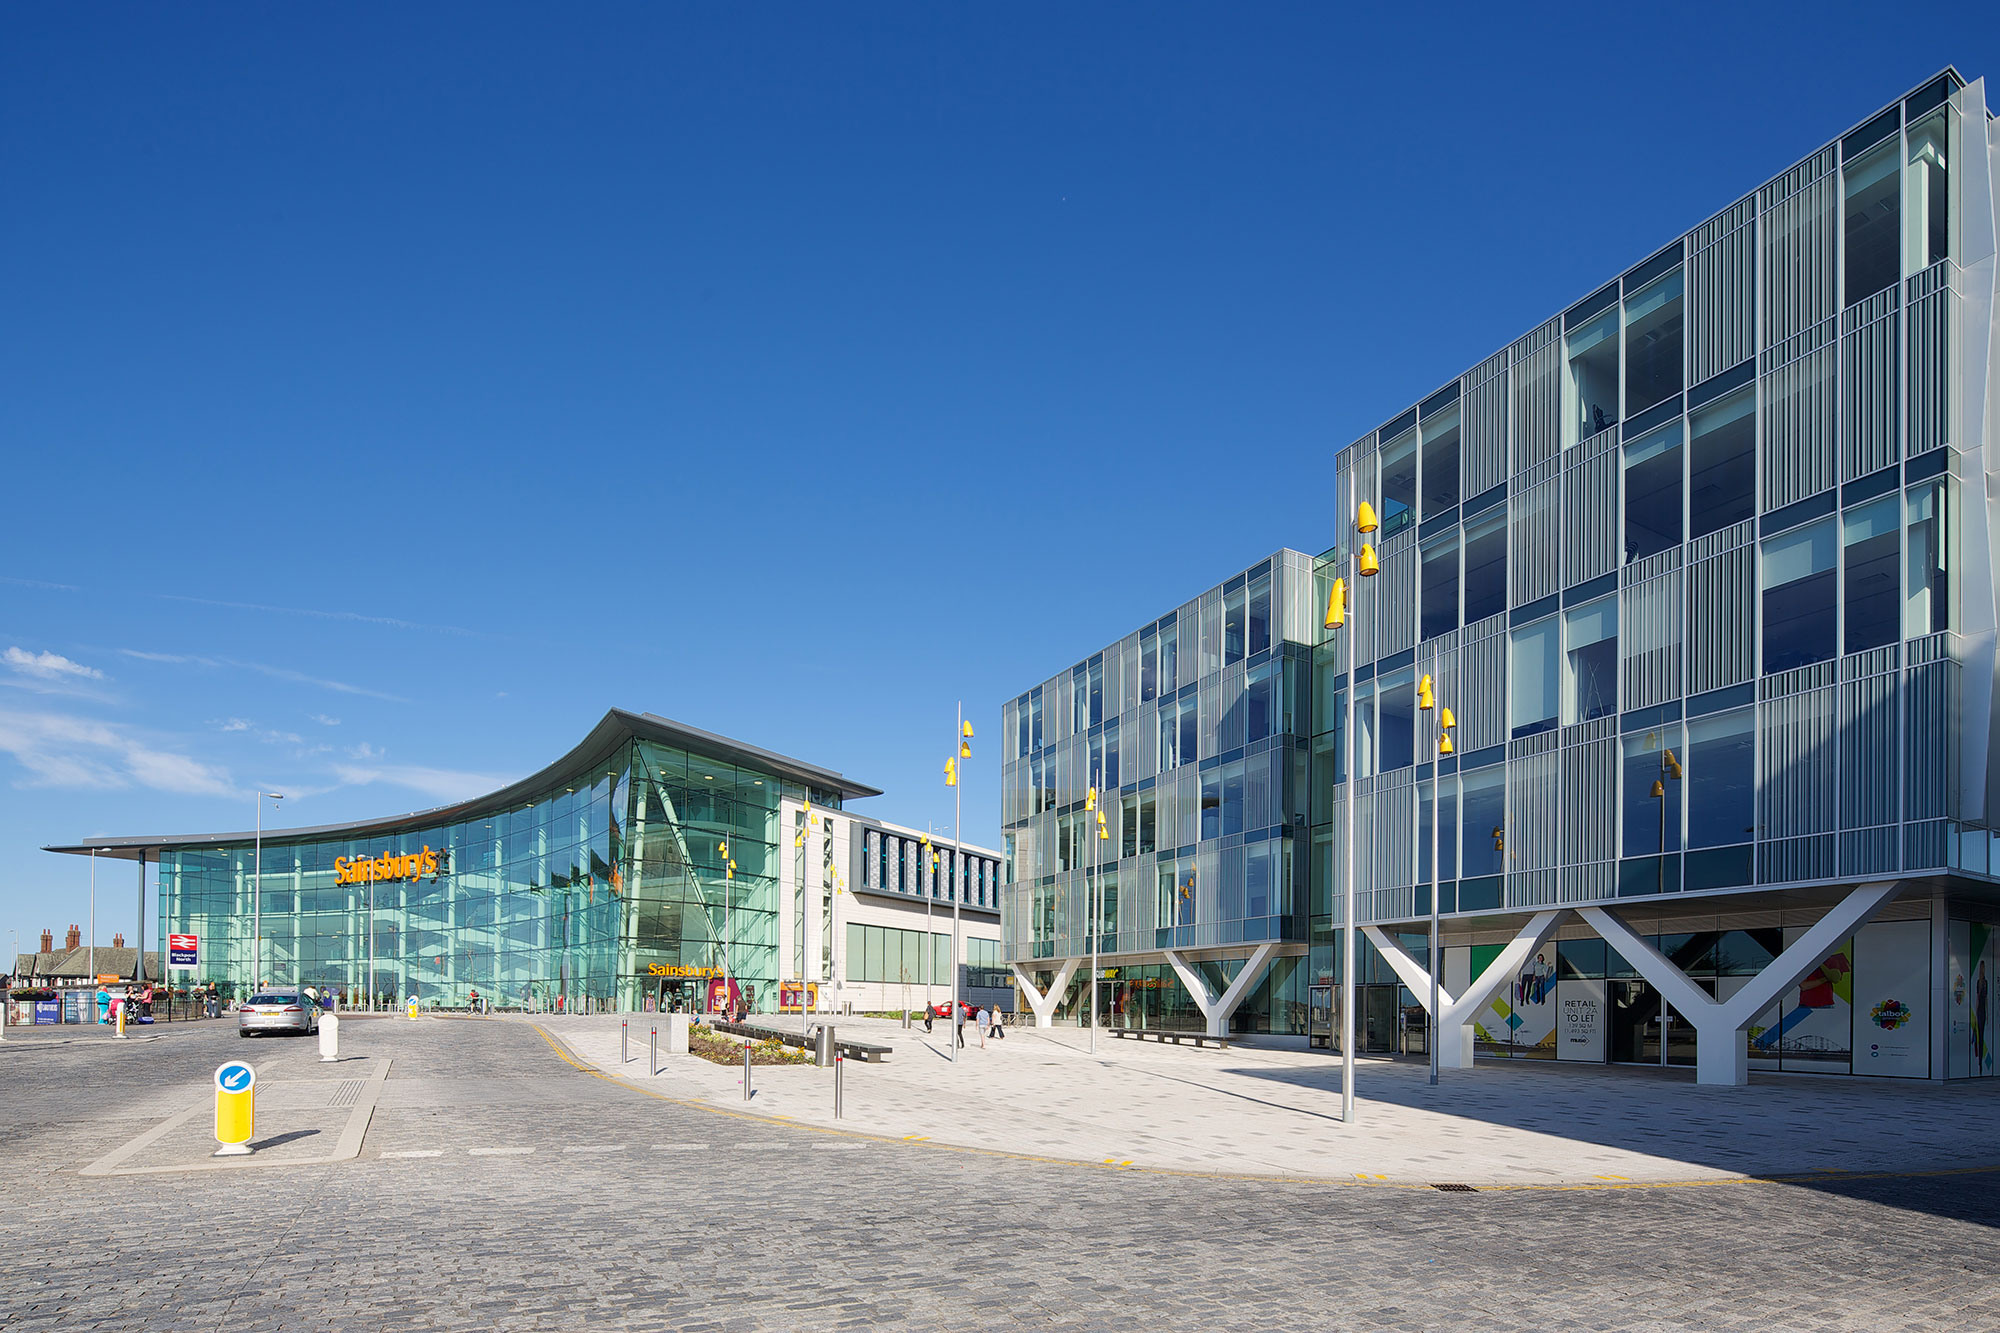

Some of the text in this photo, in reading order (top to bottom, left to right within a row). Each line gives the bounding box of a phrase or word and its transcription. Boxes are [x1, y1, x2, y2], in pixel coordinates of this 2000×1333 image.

[334, 845, 437, 884] Sainsbury's
[648, 963, 725, 980] Sainsbury's
[1566, 1014, 1595, 1022] TO LET
